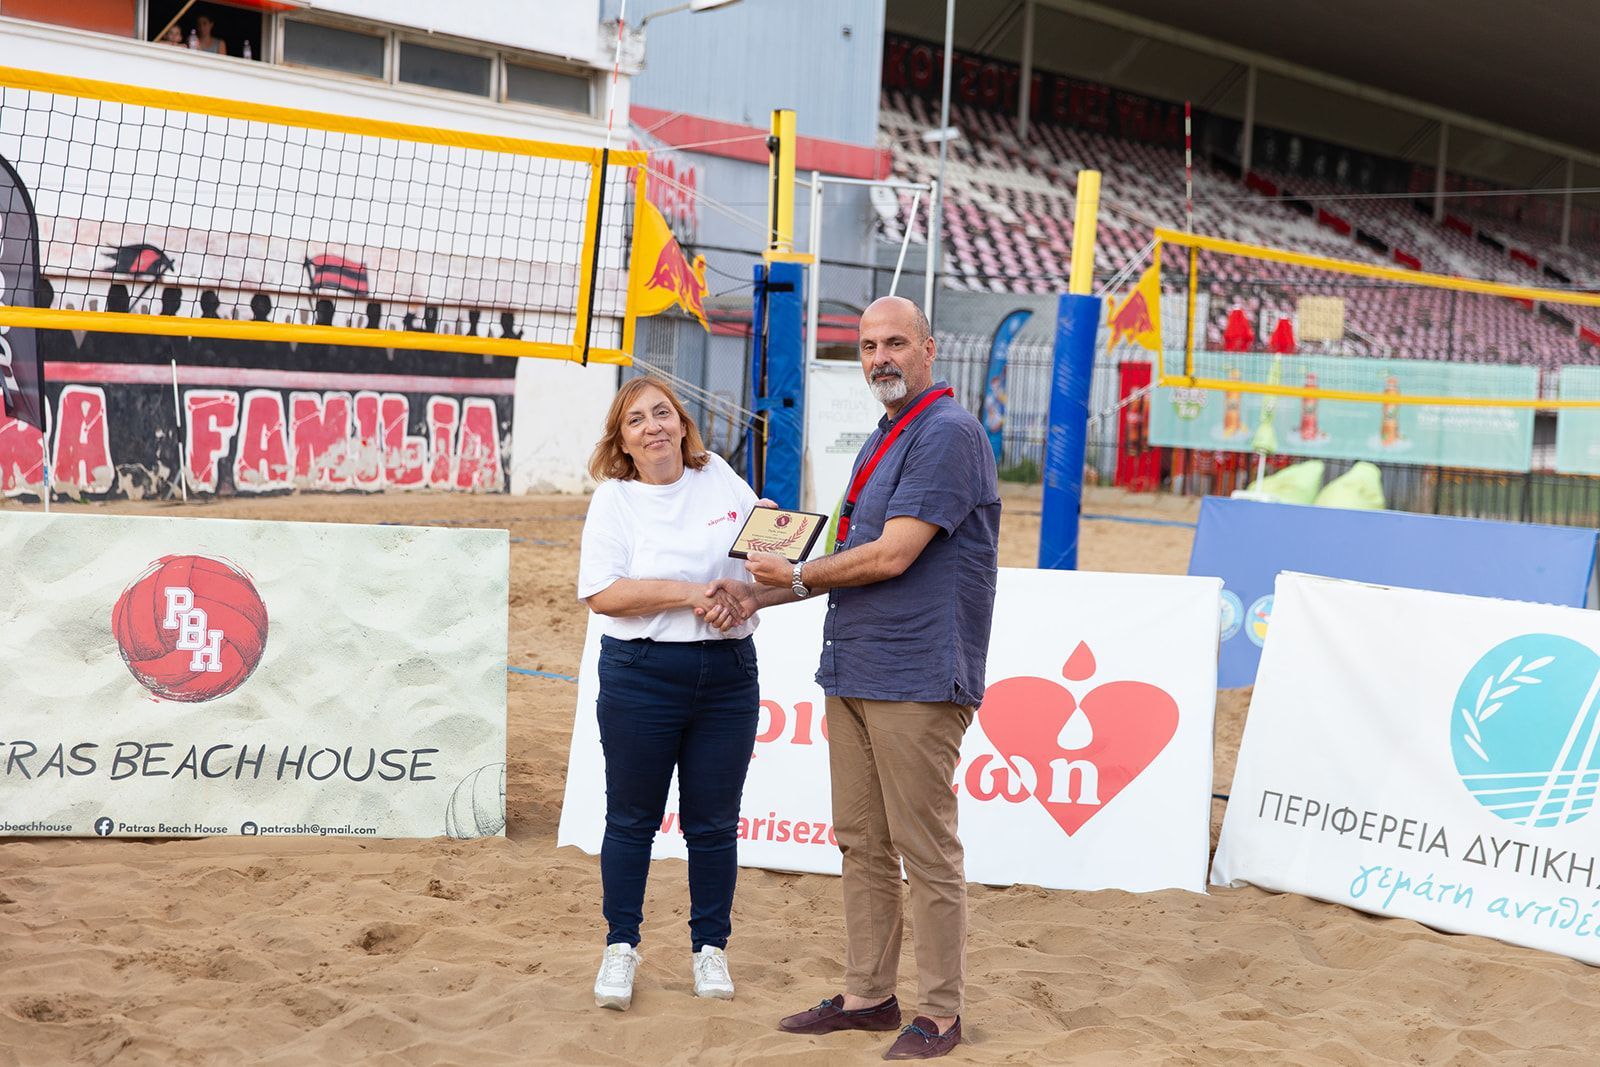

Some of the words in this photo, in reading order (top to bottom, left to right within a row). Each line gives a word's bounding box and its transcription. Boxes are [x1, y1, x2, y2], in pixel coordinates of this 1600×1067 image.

[163, 586, 224, 672] PBH
[0, 740, 99, 780] RAS
[110, 741, 266, 780] BEACH
[276, 744, 440, 782] HOUSE
[119, 822, 156, 834] Patras
[159, 823, 192, 834] Beach
[195, 823, 228, 834] House
[260, 823, 377, 836] patrasbh@gmail.com
[1258, 790, 1450, 858] ΠΕΡΙΦΕΡΕΙΑ
[1462, 834, 1600, 889] ΔΥΤΙΚΗ
[1350, 865, 1474, 910] γεμάτη
